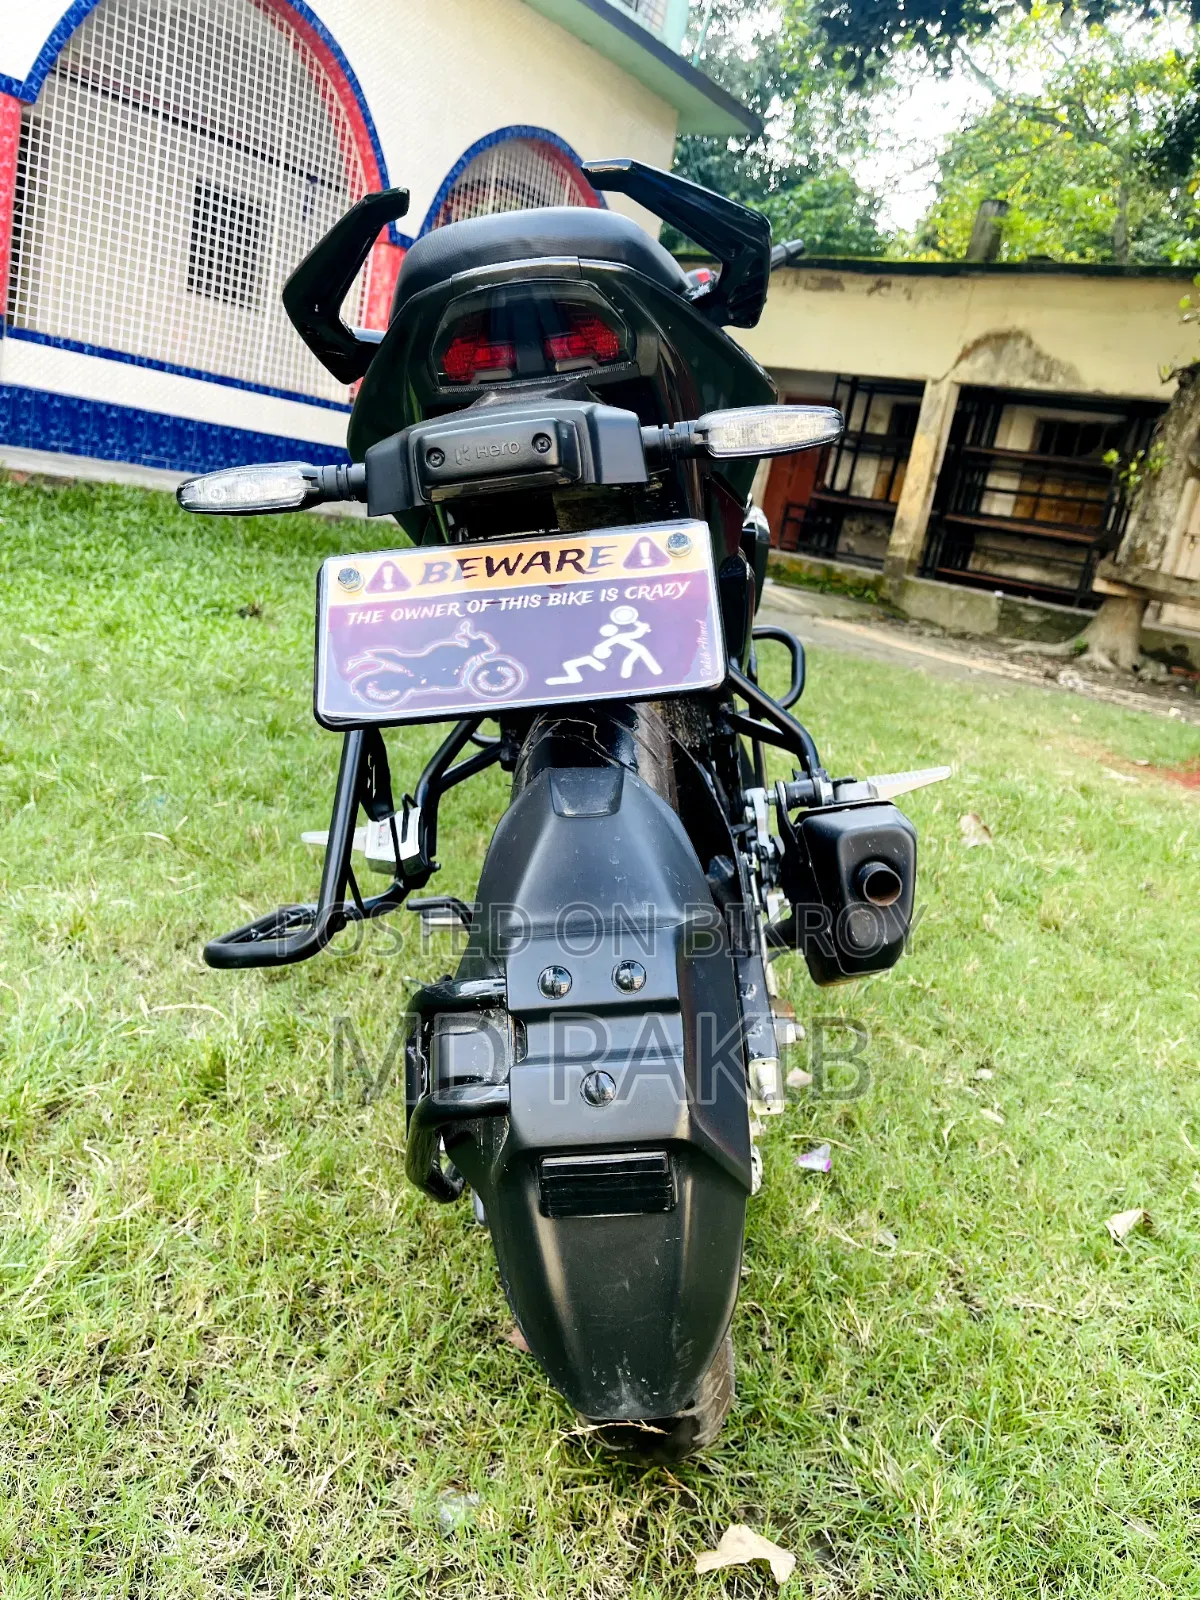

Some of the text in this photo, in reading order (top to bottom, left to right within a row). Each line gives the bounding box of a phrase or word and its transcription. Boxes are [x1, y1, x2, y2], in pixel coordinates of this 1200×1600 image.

[476, 441, 520, 459] Hero
[419, 546, 618, 585] BEWARE
[348, 581, 690, 625] THE OWNER OF THIS BIKE IS CRAZY
